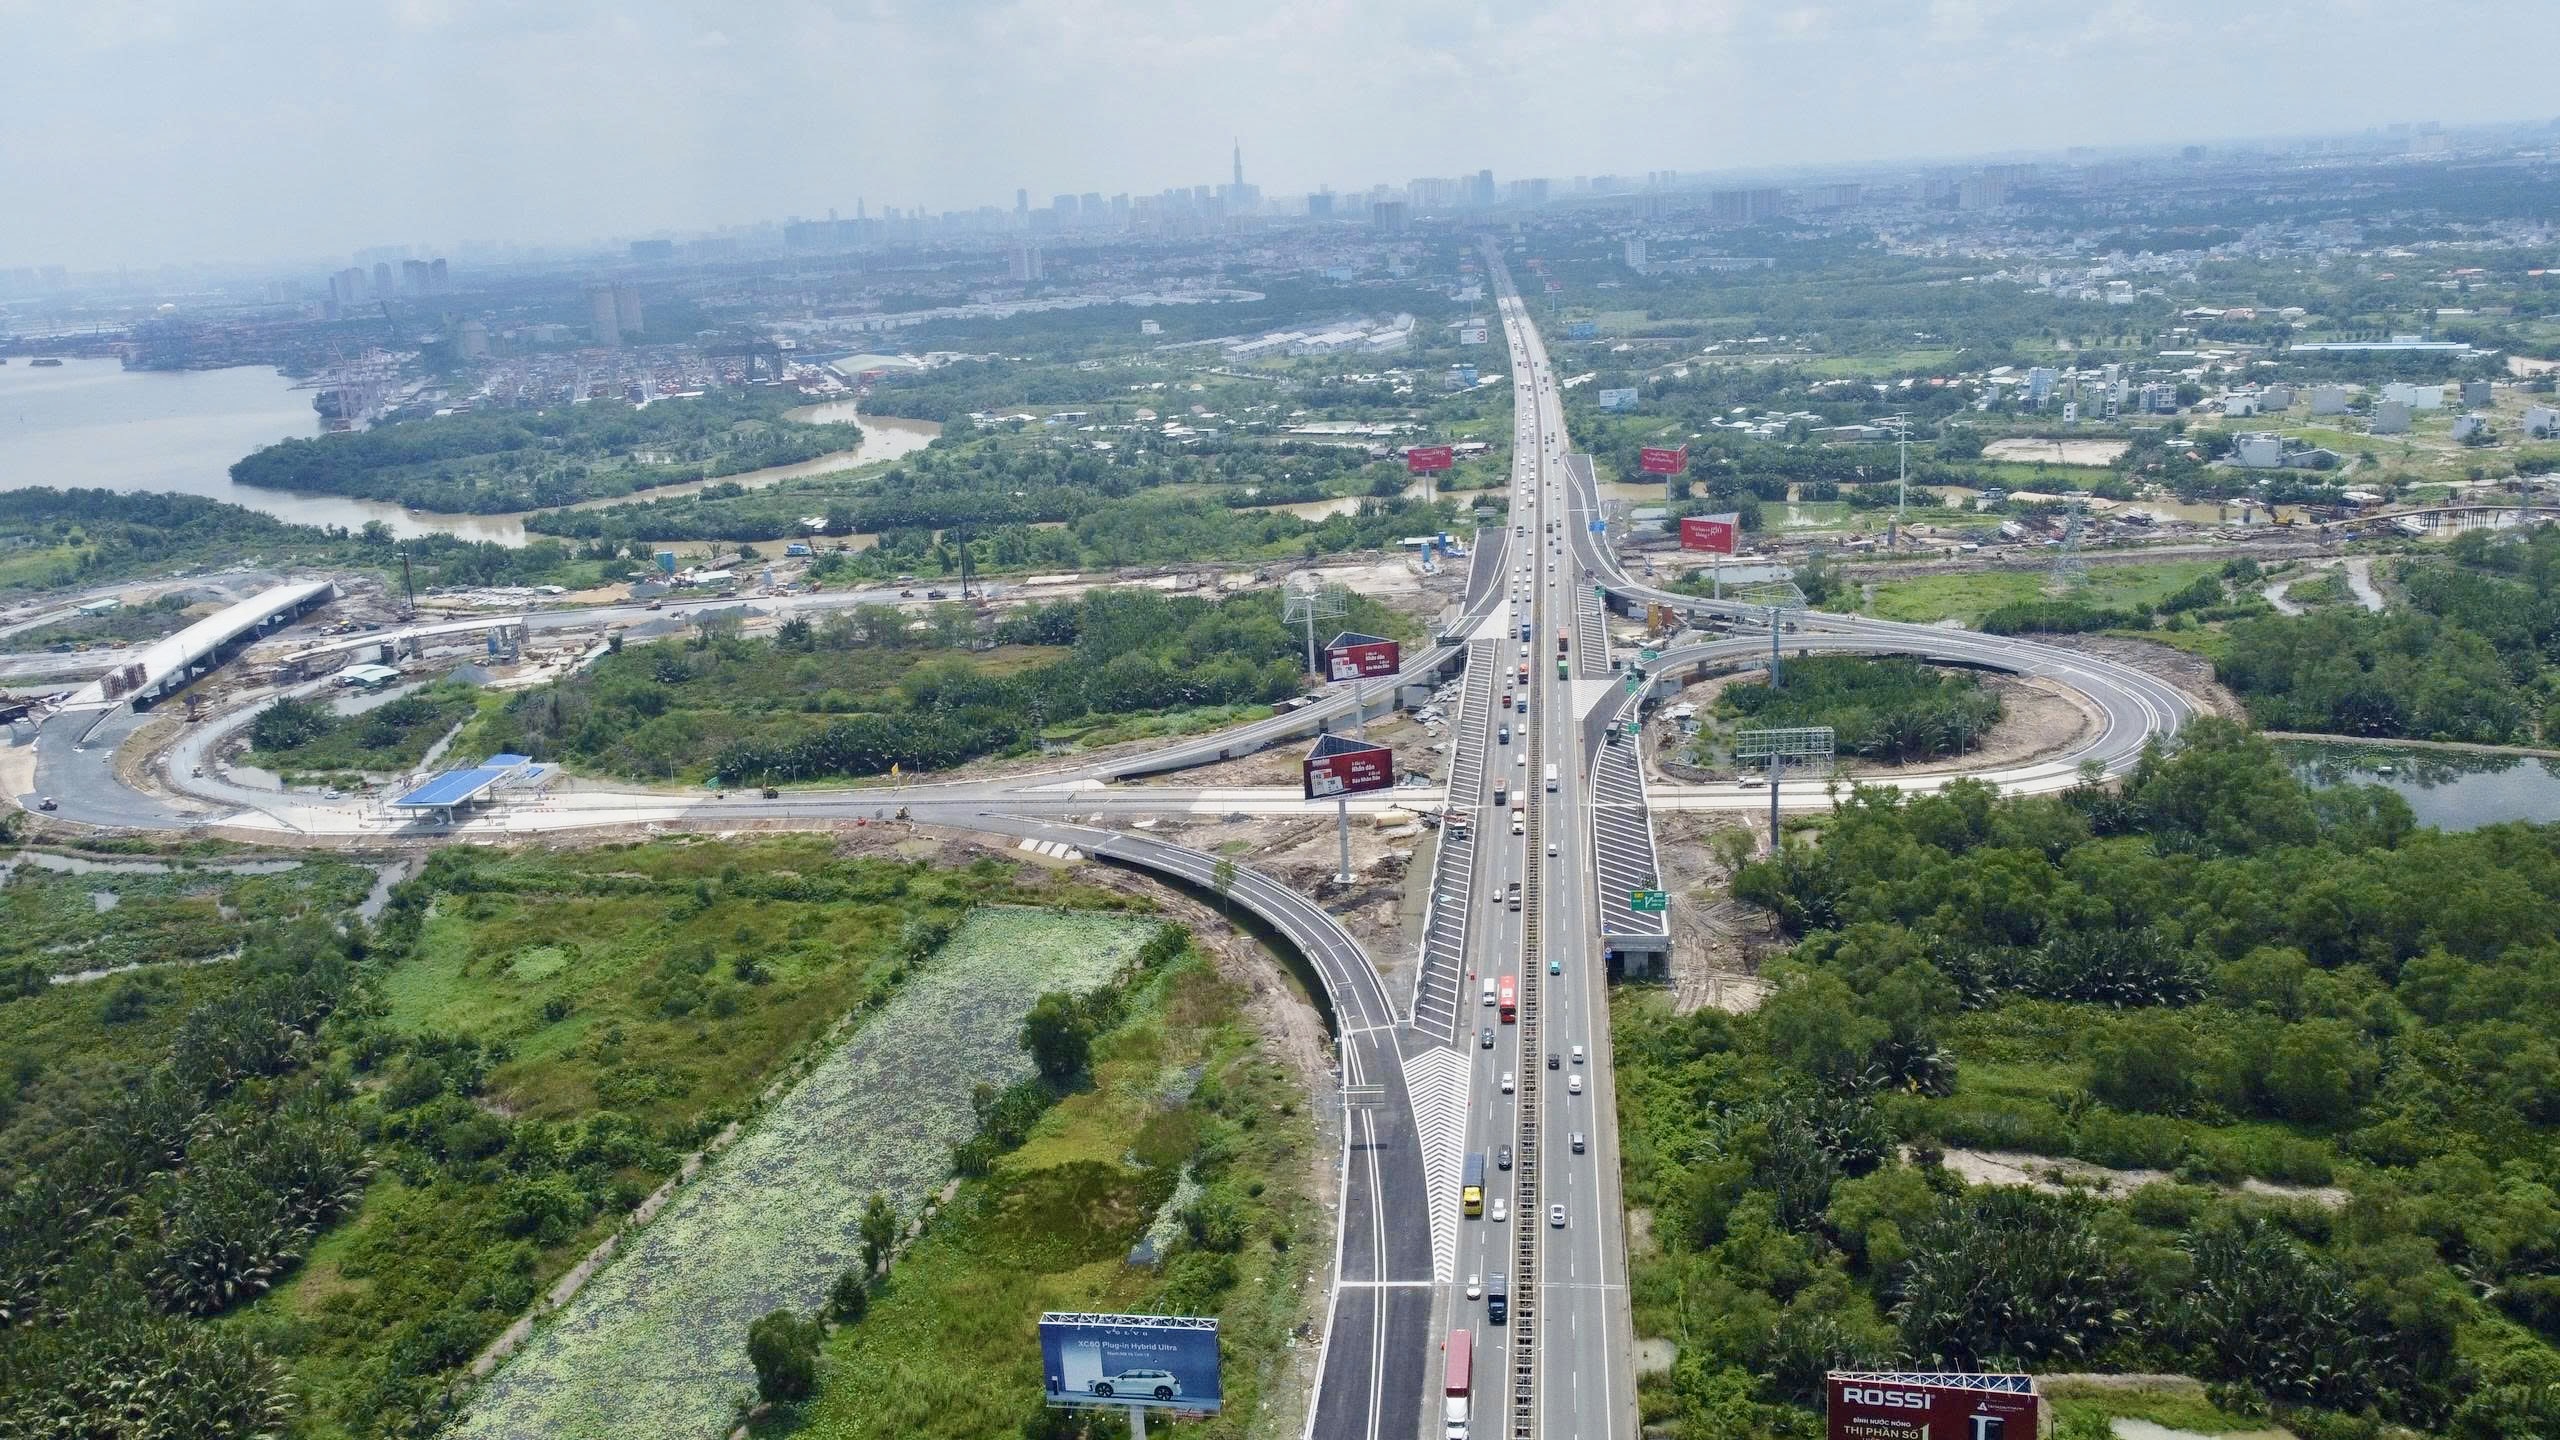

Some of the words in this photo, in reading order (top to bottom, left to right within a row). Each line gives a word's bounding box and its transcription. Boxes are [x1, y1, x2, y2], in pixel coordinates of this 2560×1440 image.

[1078, 1340, 1100, 1348] XC60
[1101, 1341, 1130, 1351] Plug-in
[1131, 1342, 1157, 1351] Hybrid
[1843, 1387, 1931, 1410] ROSSI
[1844, 1425, 1863, 1436] THỊ
[1866, 1425, 1899, 1438] PHẦN
[1902, 1428, 1919, 1440] SỐ
